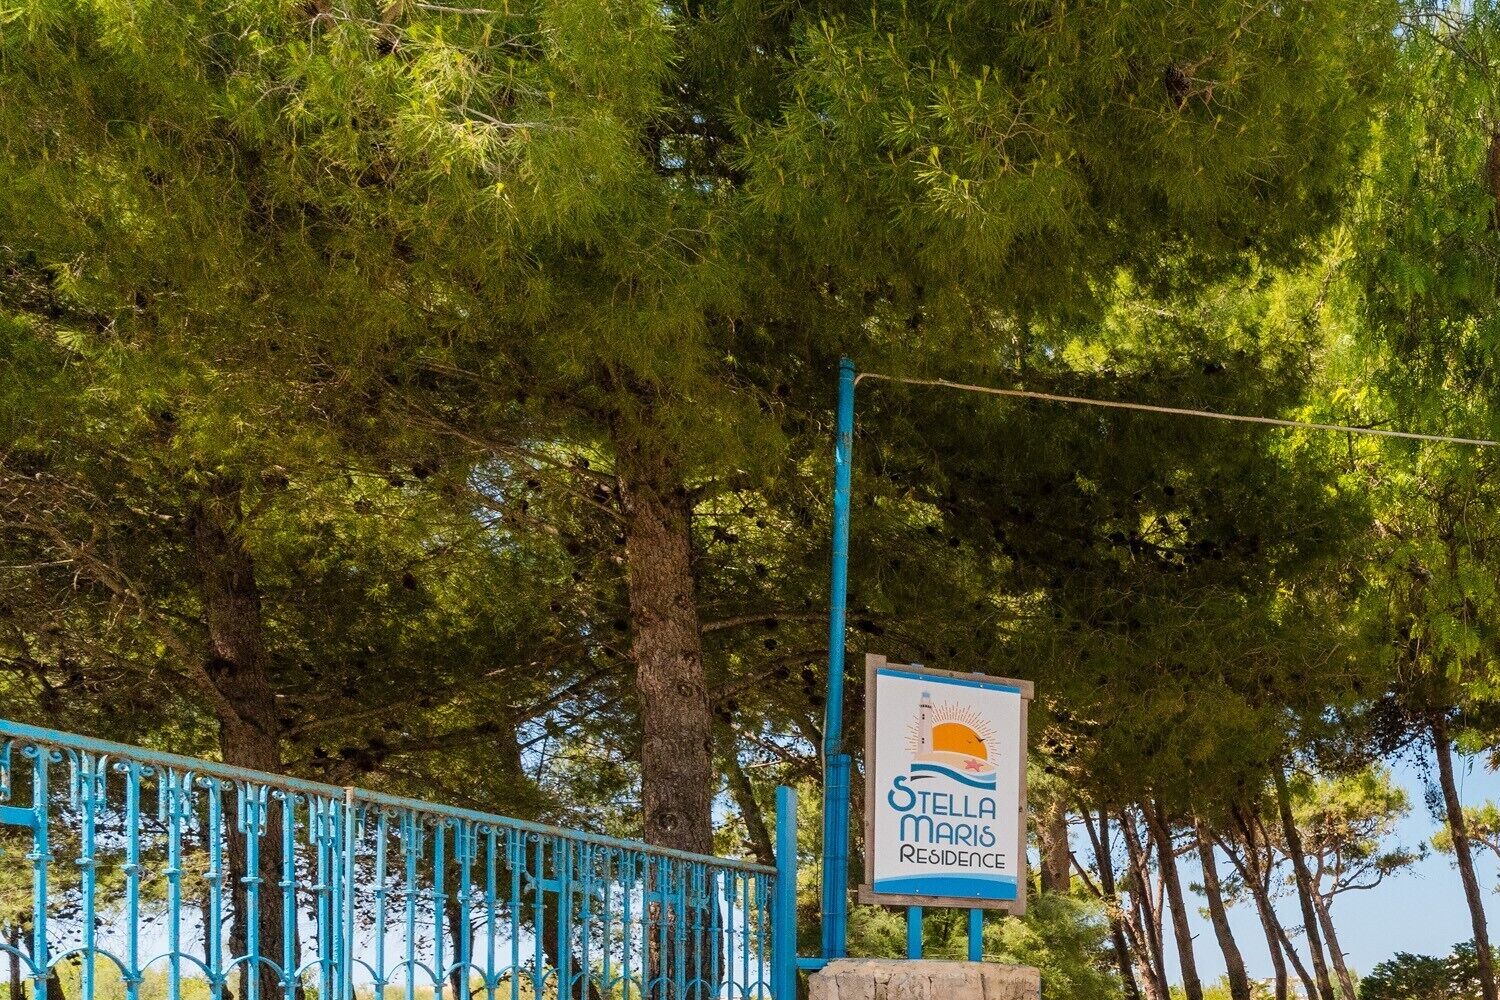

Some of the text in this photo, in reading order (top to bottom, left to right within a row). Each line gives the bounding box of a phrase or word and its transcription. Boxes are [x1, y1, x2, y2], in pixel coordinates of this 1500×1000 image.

[887, 775, 996, 819] STELLA
[900, 814, 996, 848] MARIS
[900, 844, 1006, 869] RESIDENCE
